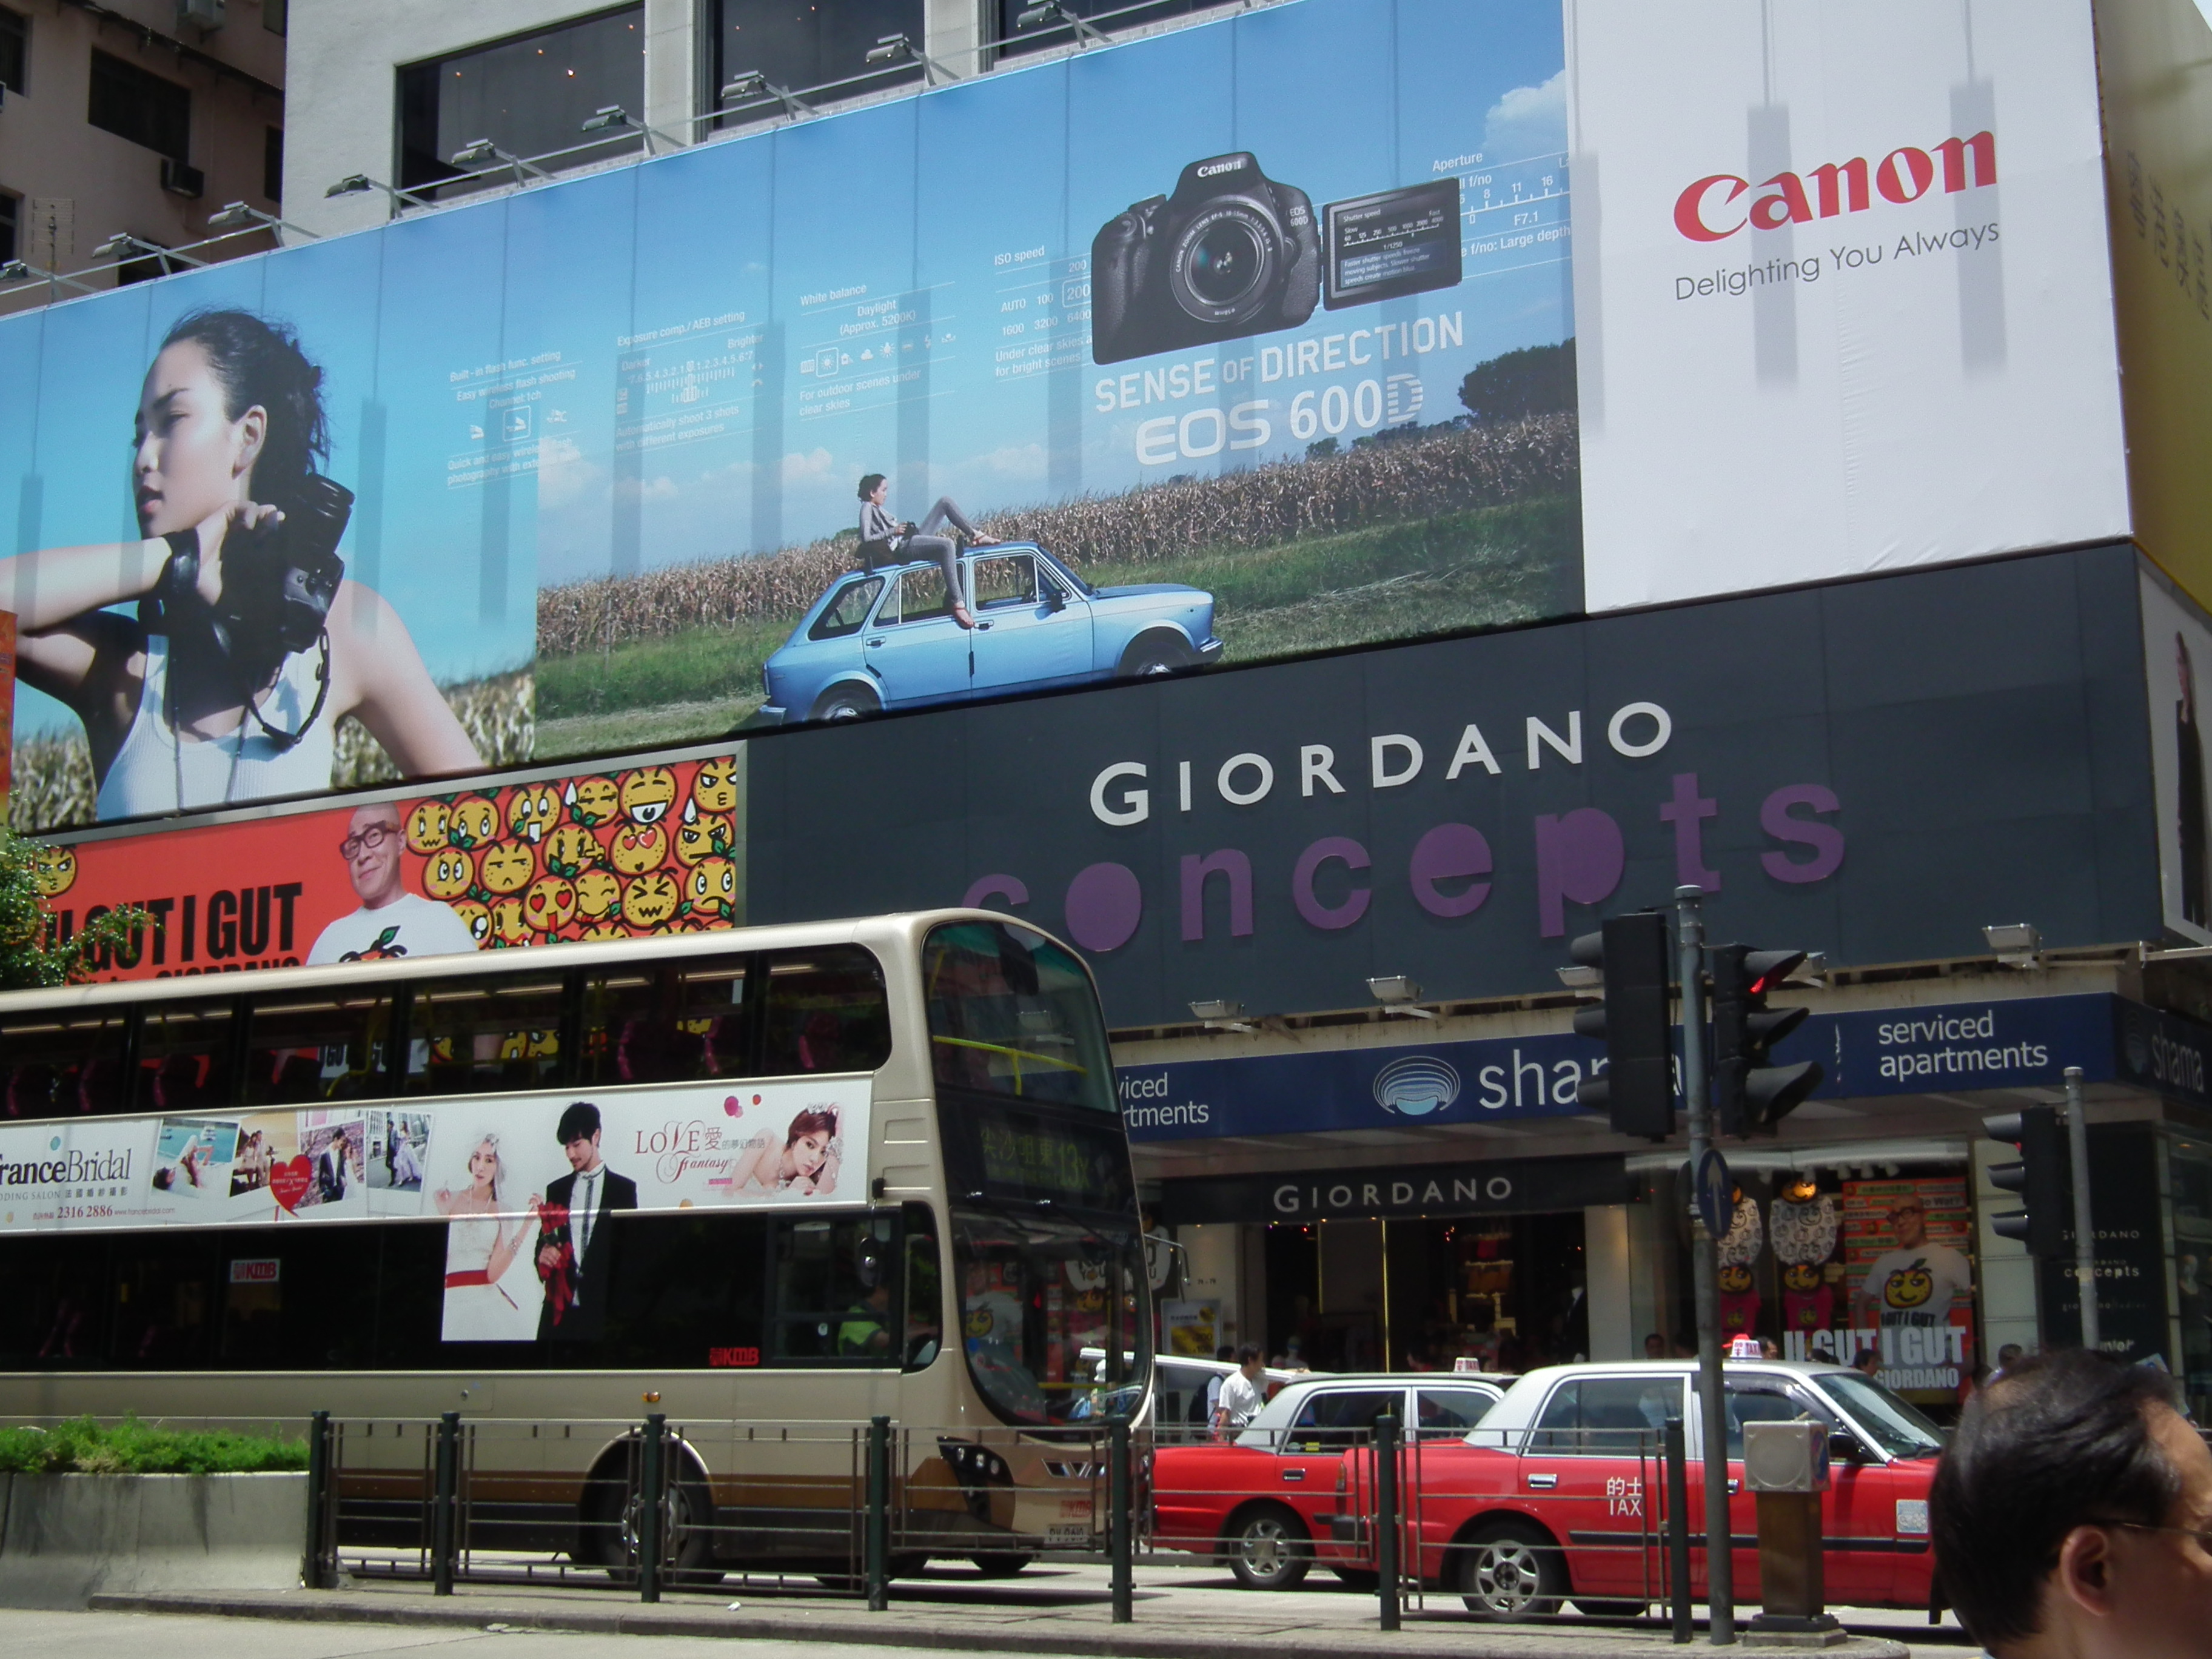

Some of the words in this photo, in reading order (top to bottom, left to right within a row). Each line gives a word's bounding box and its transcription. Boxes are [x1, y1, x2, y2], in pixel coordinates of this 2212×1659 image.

[1197, 158, 1242, 178] Canon
[1432, 153, 1483, 172] Aperture
[1483, 189, 1490, 199] 8
[1511, 182, 1521, 192] 11
[1541, 175, 1553, 187] 16
[1674, 130, 1997, 242] Canon
[1290, 206, 1305, 216] EOS
[1290, 215, 1309, 227] 600D
[1343, 213, 1362, 223] Shutter
[1364, 209, 1381, 219] speed
[1514, 211, 1538, 226] F7.1
[1500, 233, 1533, 250] Large
[1537, 226, 1570, 244] depth
[994, 253, 1011, 266] ISO
[1014, 245, 1045, 262] speed
[1175, 250, 1184, 272] CANON
[1182, 230, 1195, 248] ZOOM
[1344, 259, 1361, 267] Faster
[1362, 255, 1381, 264] shutter
[1676, 256, 1820, 300] Delighting
[1830, 246, 1883, 270] You
[1893, 222, 1999, 260] Always
[1069, 260, 1087, 272] 200
[800, 292, 826, 306] White
[830, 285, 867, 300] balance
[1001, 298, 1026, 312] AUTO
[1037, 293, 1053, 305] 100
[1067, 284, 1091, 301] 200
[857, 300, 897, 317] Daylight
[617, 330, 657, 346] Exposure
[692, 318, 711, 330] AEB
[714, 312, 745, 326] setting
[840, 321, 879, 336] (Approx.
[1002, 323, 1024, 335] 1600
[1034, 317, 1058, 330] 3200
[1067, 309, 1091, 323] 6400
[728, 333, 764, 349] Brighter
[996, 347, 1025, 362] Under
[1028, 341, 1053, 356] clear
[1057, 336, 1084, 350] skies
[531, 352, 561, 365] setting
[996, 366, 1008, 377] for
[1013, 359, 1042, 374] bright
[1045, 353, 1081, 367] scenes
[1095, 361, 1215, 414] SENSE
[1223, 357, 1250, 384] OF
[1261, 311, 1463, 384] DIRECTION
[457, 390, 476, 401] Easy
[478, 383, 514, 397] wireless
[516, 377, 537, 388] flash
[539, 369, 575, 384] shooting
[800, 389, 814, 401] For
[818, 383, 853, 398] outdoor
[856, 375, 890, 390] scenes
[893, 370, 922, 383] under
[799, 403, 823, 416] clear
[825, 398, 850, 412] skies
[1136, 399, 1270, 465] EOS
[1289, 373, 1424, 440] 600D
[617, 418, 676, 437] Automatically
[679, 412, 704, 426] shoot
[706, 411, 712, 420] 3
[715, 406, 739, 417] shots
[637, 432, 675, 447] different
[678, 423, 725, 440] exposures
[1090, 701, 1672, 828] GIORDANO
[84, 897, 174, 971] GUT
[181, 895, 195, 962] I
[207, 882, 302, 960] GUT
[1879, 1010, 1994, 1044] serviced
[1880, 1041, 2048, 1082] apartments
[2153, 1022, 2204, 1093] shama
[1119, 1071, 1168, 1099] iced
[1123, 1101, 1209, 1127] tments
[635, 1120, 705, 1154] LOVE
[0, 1148, 132, 1185] ranceBridal
[656, 1150, 729, 1184] Fantasy
[32, 1190, 60, 1200] SALON
[1274, 1177, 1512, 1212] GIORDANO
[57, 1205, 83, 1219] 2316
[86, 1205, 113, 1218] 2886
[723, 1347, 759, 1366] KMB
[1746, 1342, 1761, 1355] TAXI
[1900, 1326, 1966, 1364] GUT
[1877, 1367, 1959, 1389] GIORDANO
[1607, 1476, 1641, 1496] 的士
[1610, 1499, 1641, 1516] TAX
